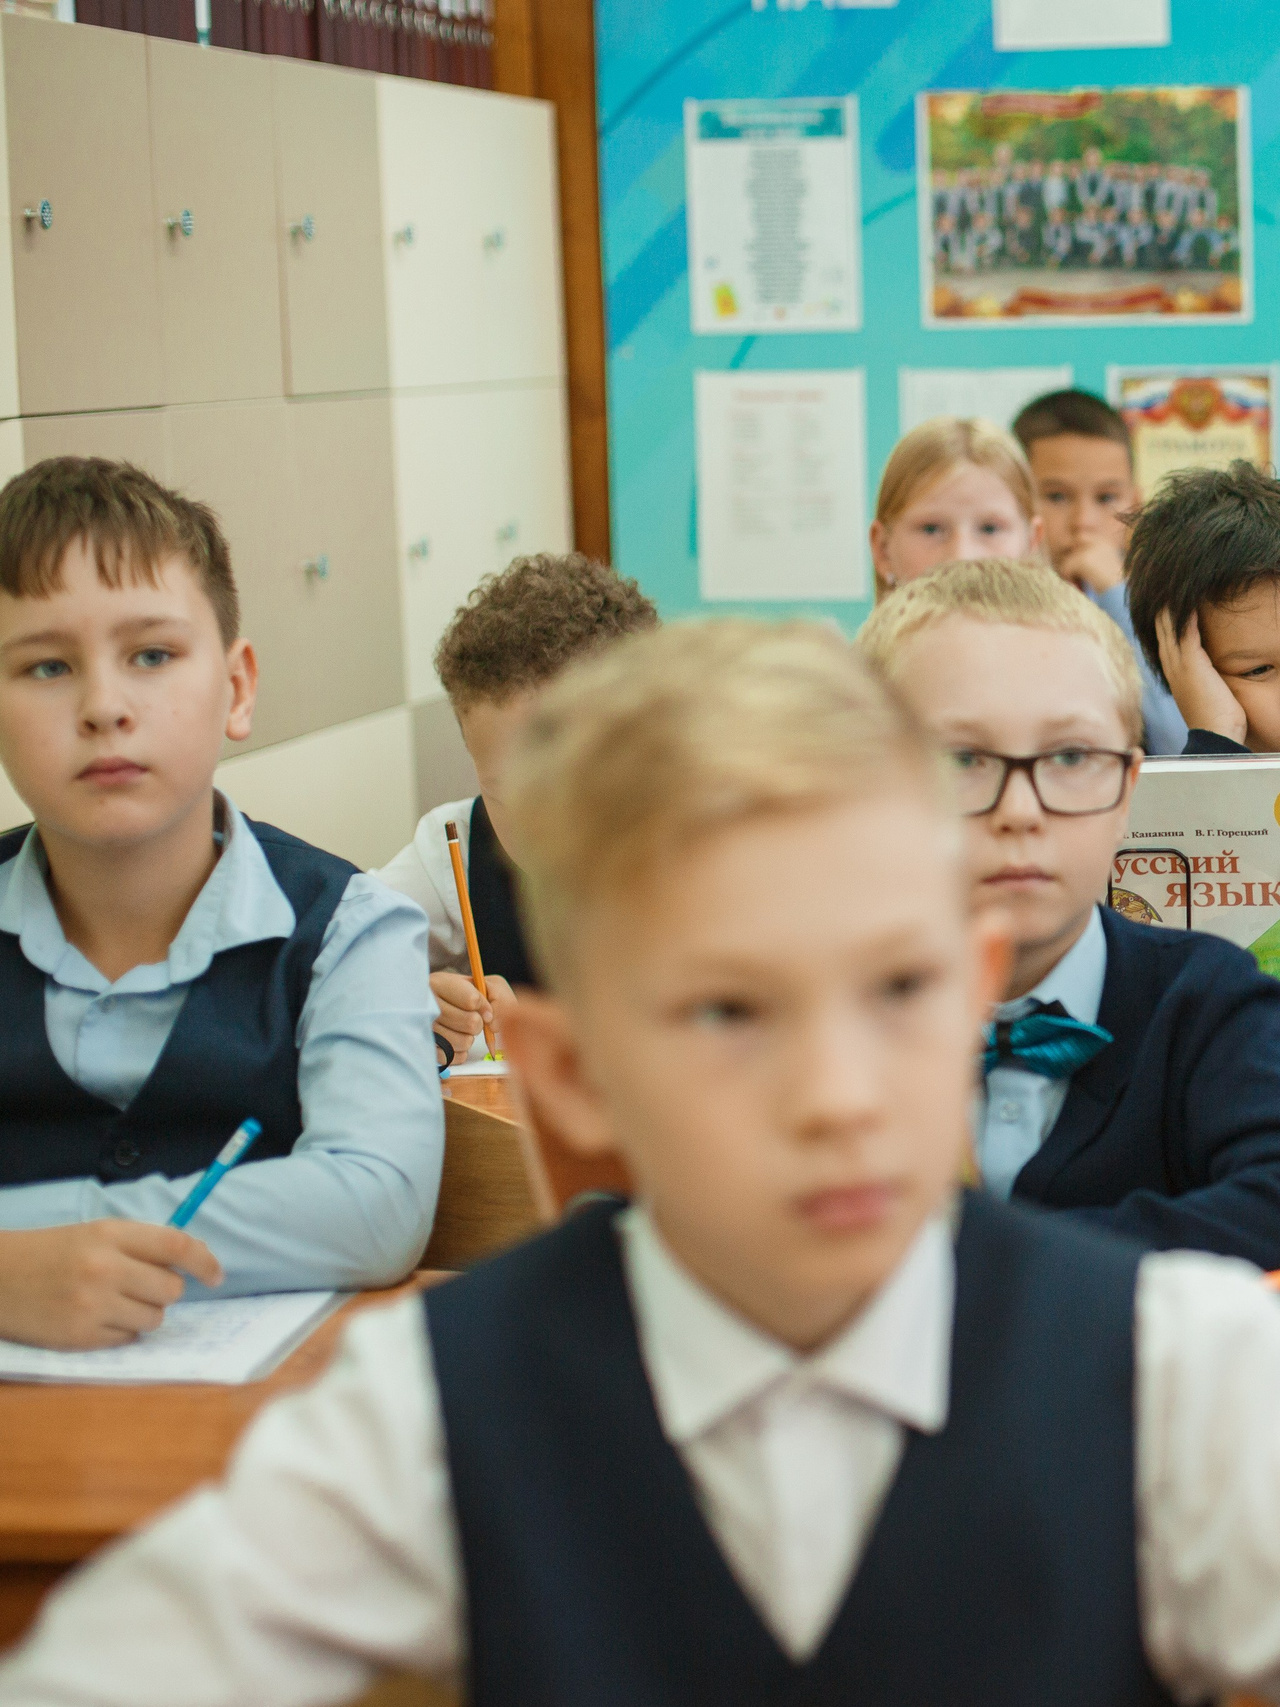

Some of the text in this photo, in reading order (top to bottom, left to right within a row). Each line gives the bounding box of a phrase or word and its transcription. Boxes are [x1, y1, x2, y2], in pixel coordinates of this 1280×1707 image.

[1131, 830, 1184, 839] Канакина
[1195, 829, 1205, 837] В.
[1207, 829, 1215, 837] Г.
[1217, 828, 1269, 839] Горецкий
[1112, 850, 1240, 884] усский
